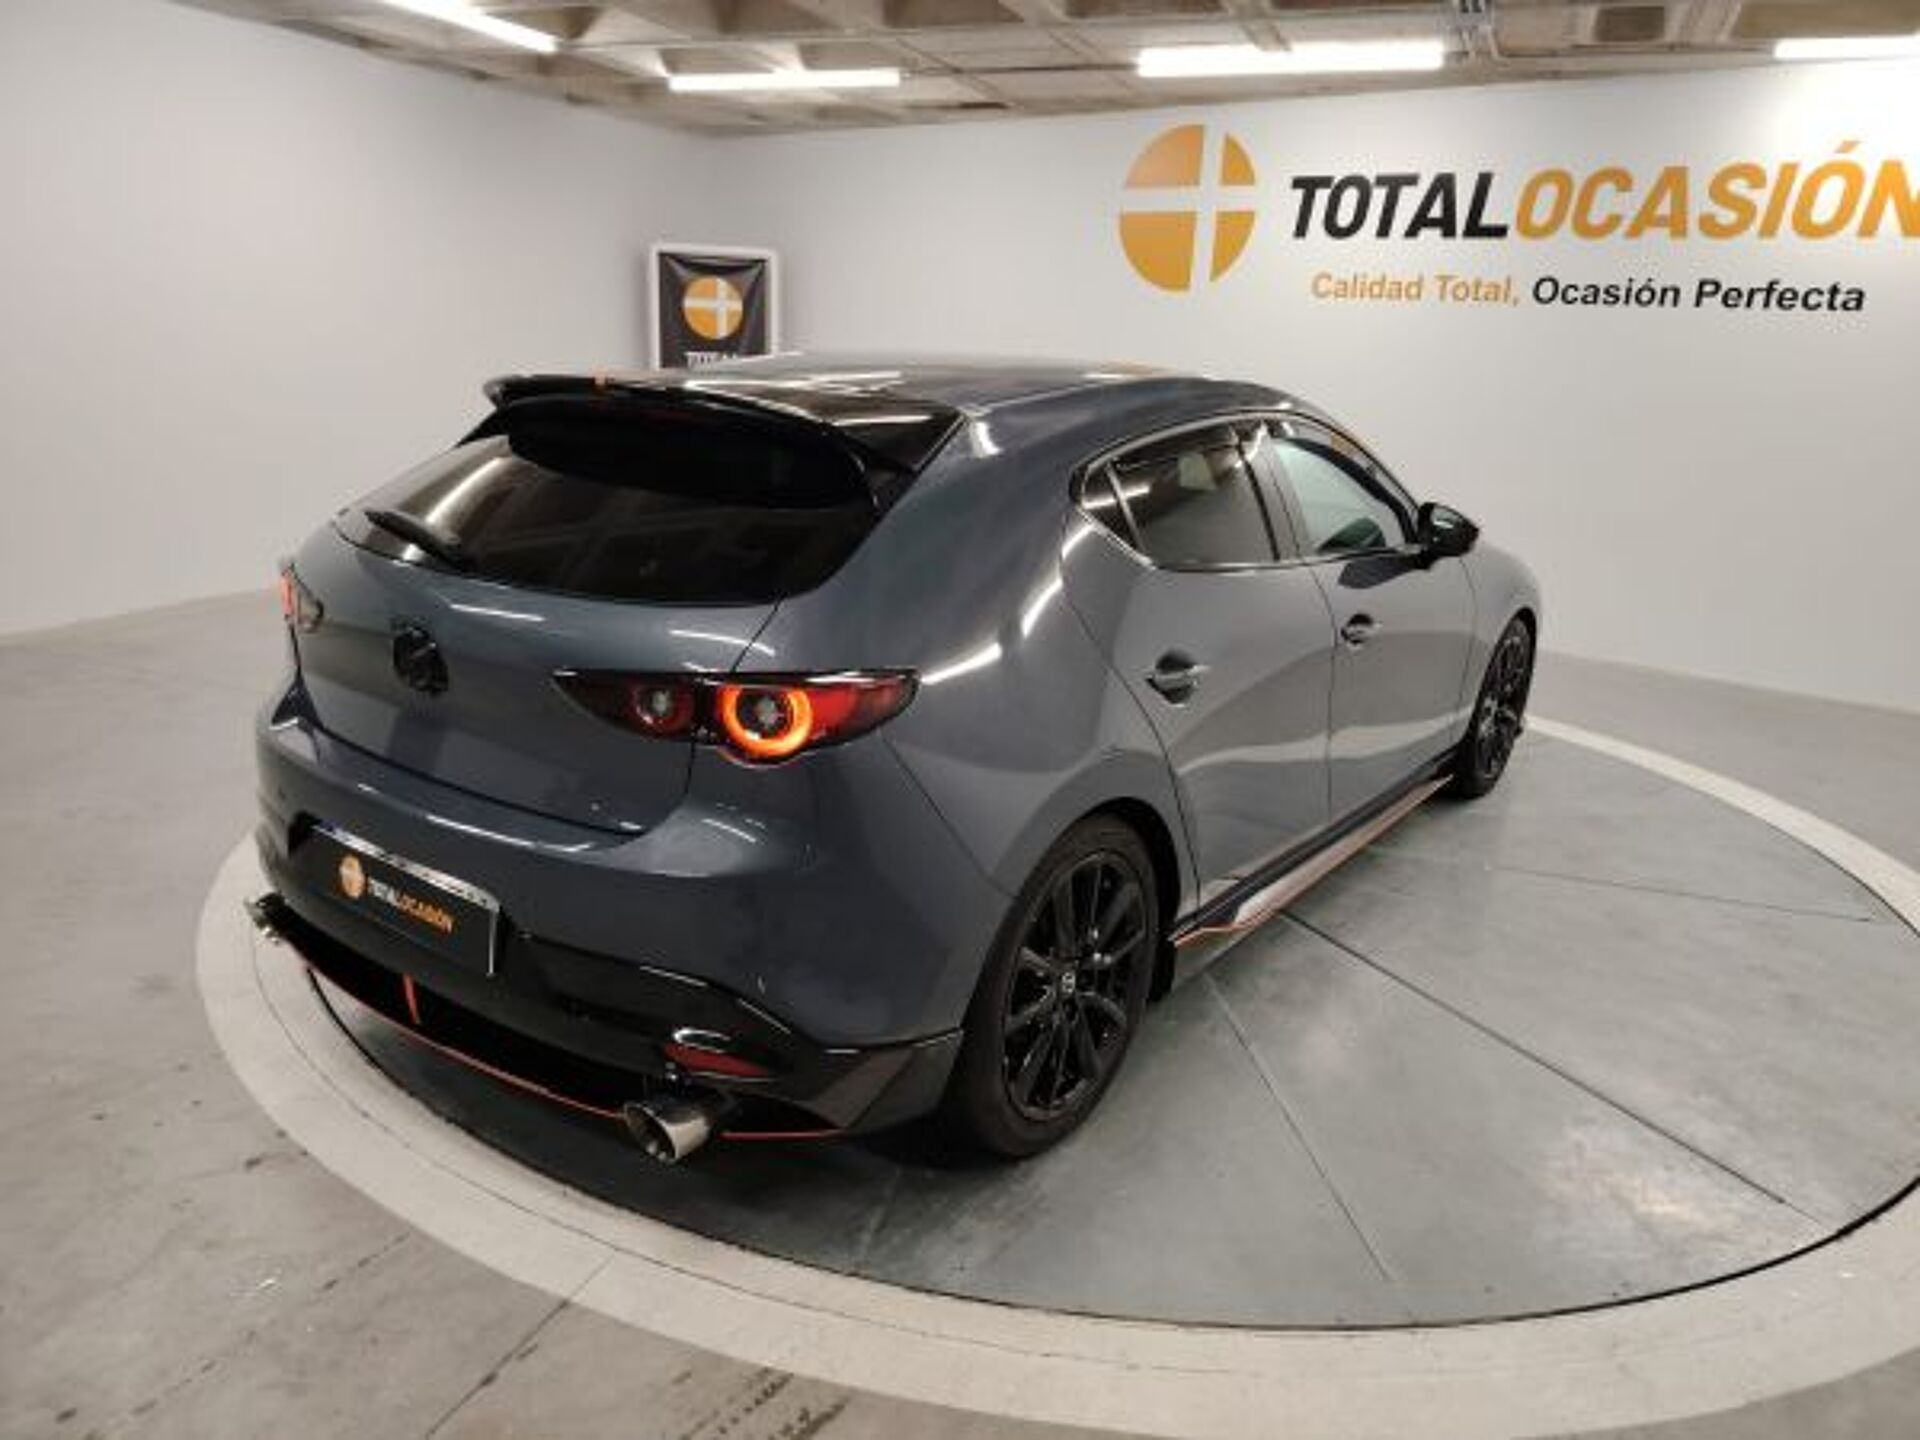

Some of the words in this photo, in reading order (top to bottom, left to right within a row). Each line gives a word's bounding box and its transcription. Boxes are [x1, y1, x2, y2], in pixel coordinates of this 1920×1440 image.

[1311, 272, 1424, 301] Calidad
[1434, 275, 1518, 306] Total,
[1532, 277, 1681, 308] Ocasión
[1694, 278, 1866, 312] Perfecta
